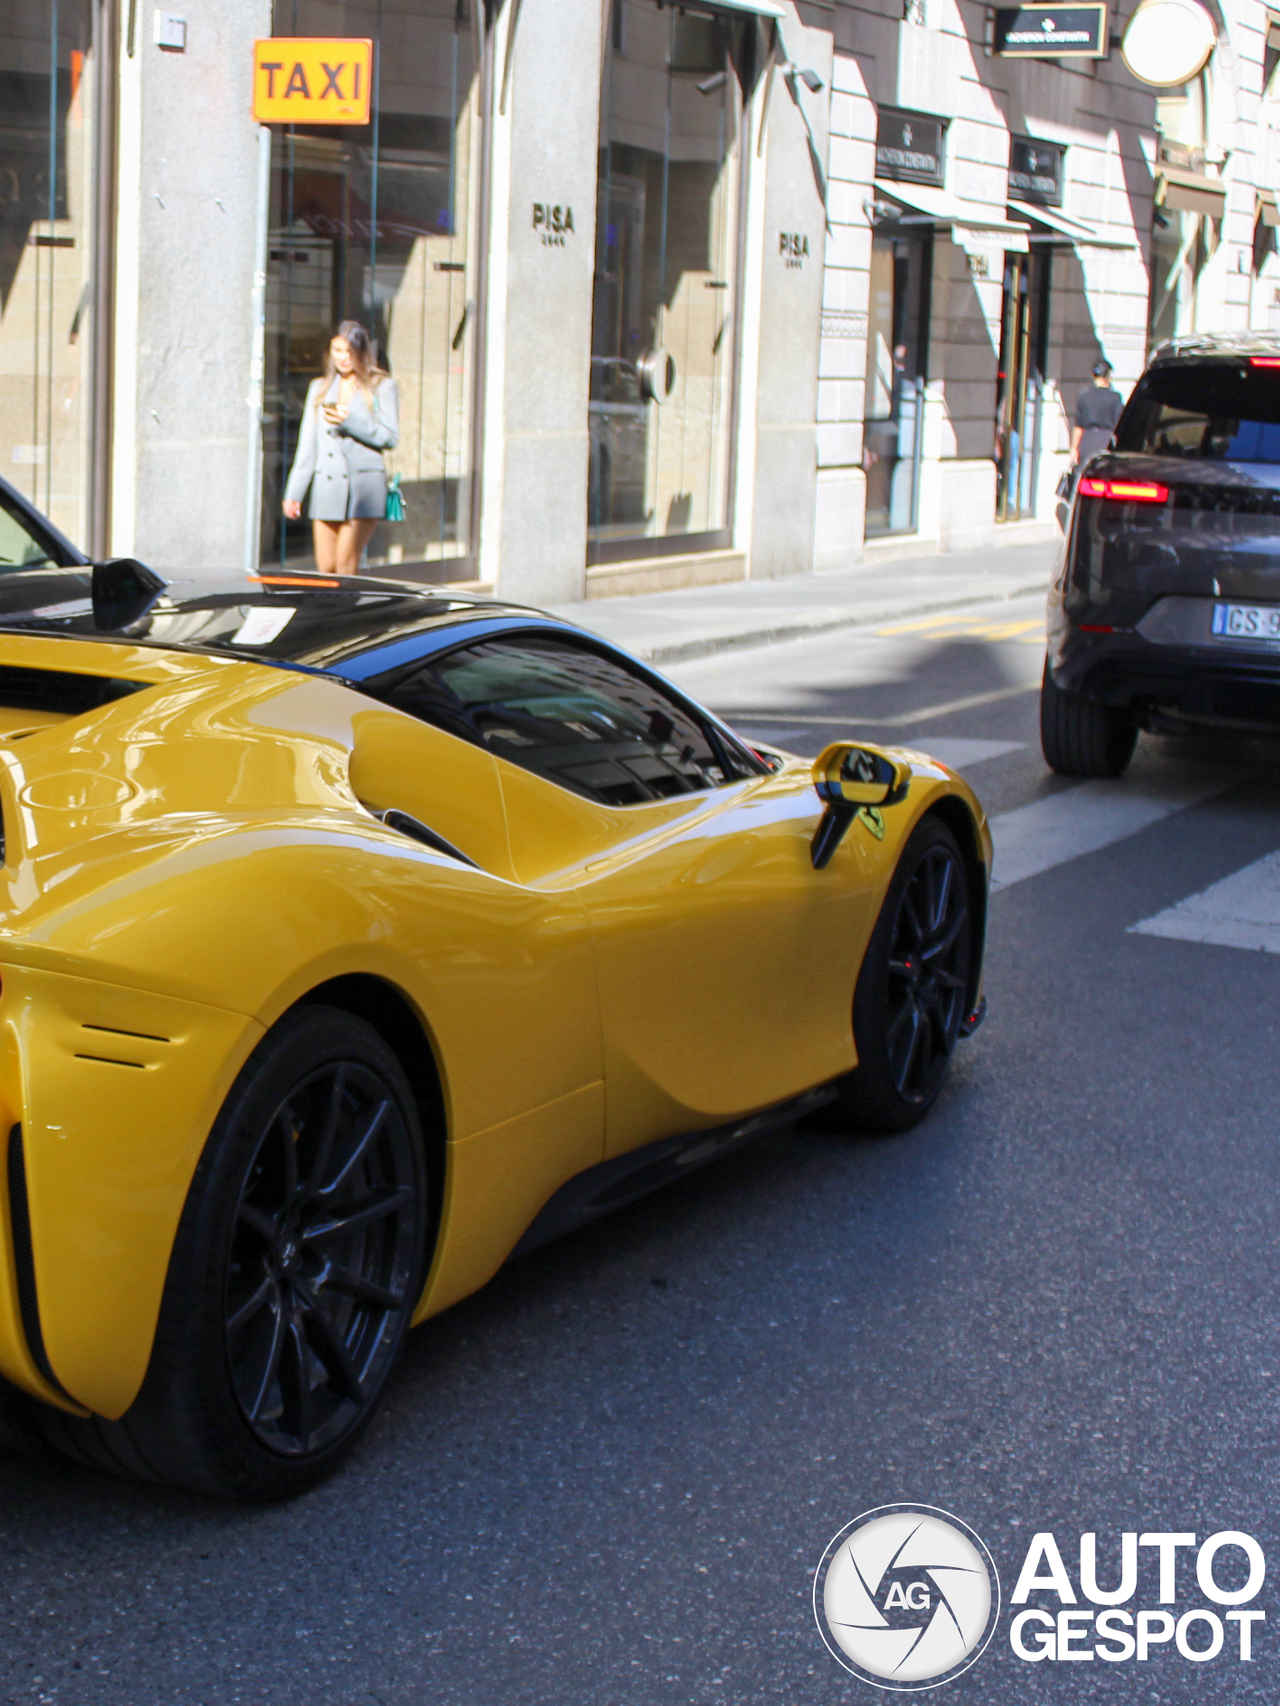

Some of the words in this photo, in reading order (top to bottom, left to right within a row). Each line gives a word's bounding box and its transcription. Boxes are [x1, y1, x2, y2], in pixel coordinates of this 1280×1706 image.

[260, 62, 361, 99] TAXI
[532, 202, 575, 235] PISA
[780, 231, 810, 258] PISA
